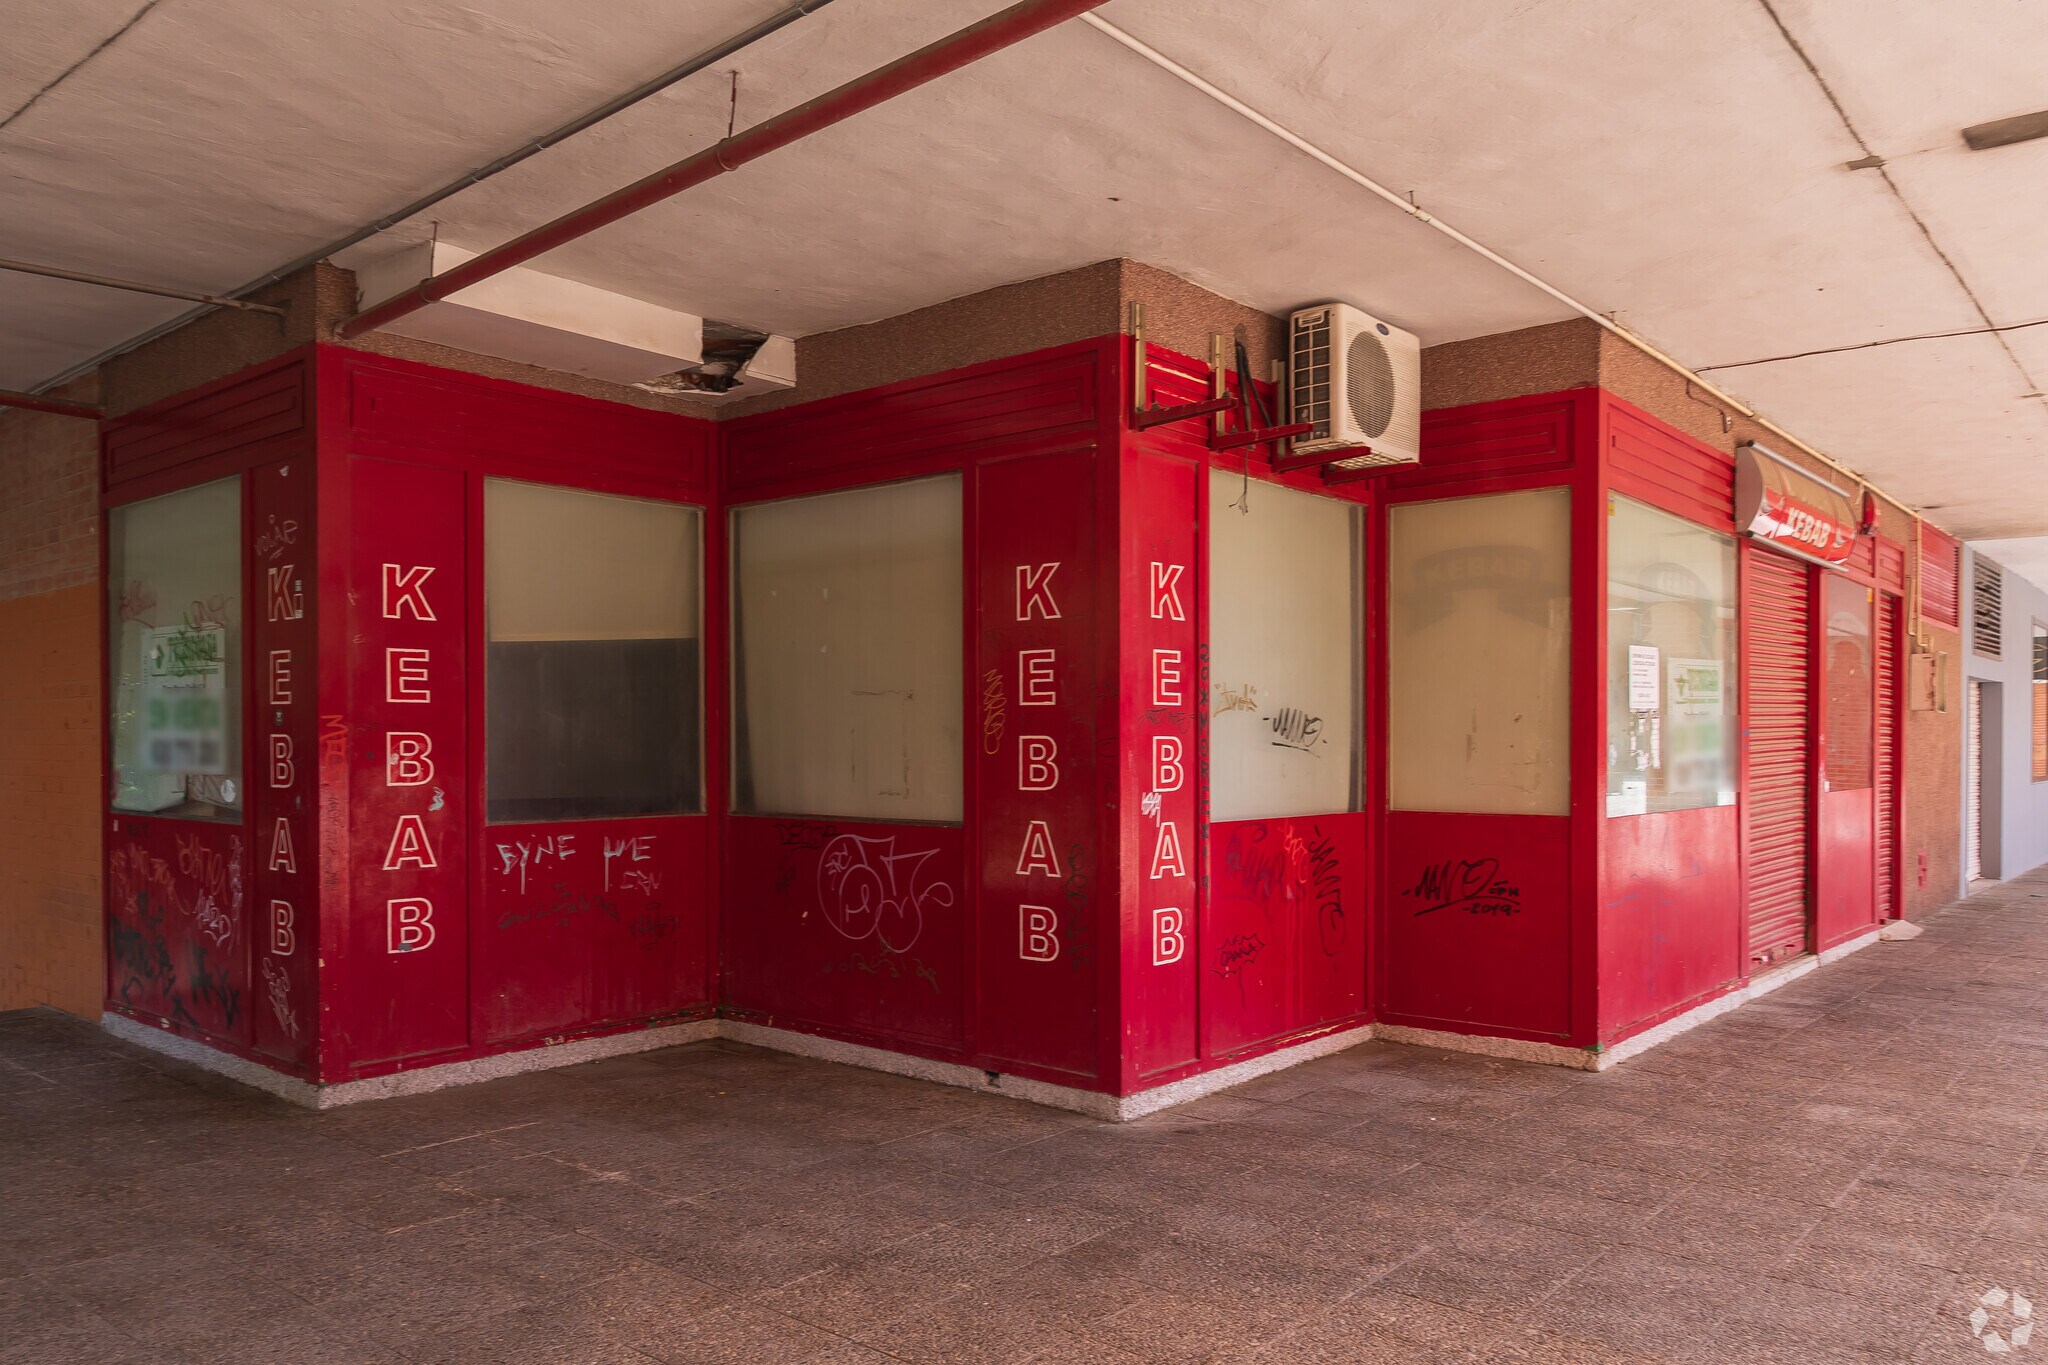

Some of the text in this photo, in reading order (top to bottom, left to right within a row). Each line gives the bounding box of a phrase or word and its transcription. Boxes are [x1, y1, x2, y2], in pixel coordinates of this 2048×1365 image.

[1786, 507, 1831, 548] KEBAB
[267, 564, 297, 956] KEBAB
[381, 562, 437, 955] KEBAB
[1015, 561, 1062, 962] KEBAB
[1149, 560, 1186, 967] KEBAB
